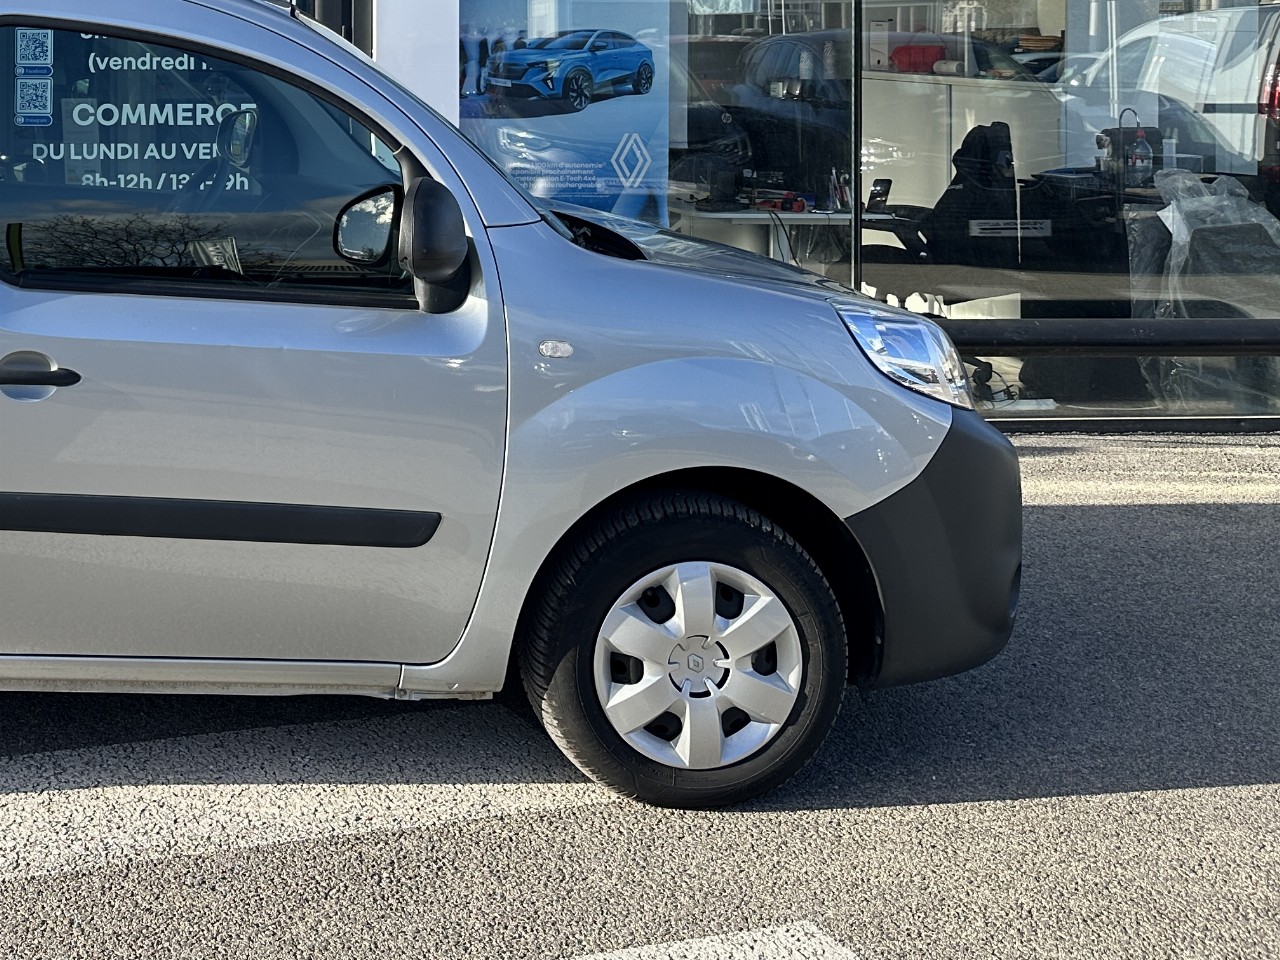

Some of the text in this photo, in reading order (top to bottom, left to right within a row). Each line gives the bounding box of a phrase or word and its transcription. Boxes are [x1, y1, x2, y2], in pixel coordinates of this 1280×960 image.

[32, 143, 65, 160] DU
[70, 143, 139, 160] LUNDI
[144, 143, 177, 160] AU
